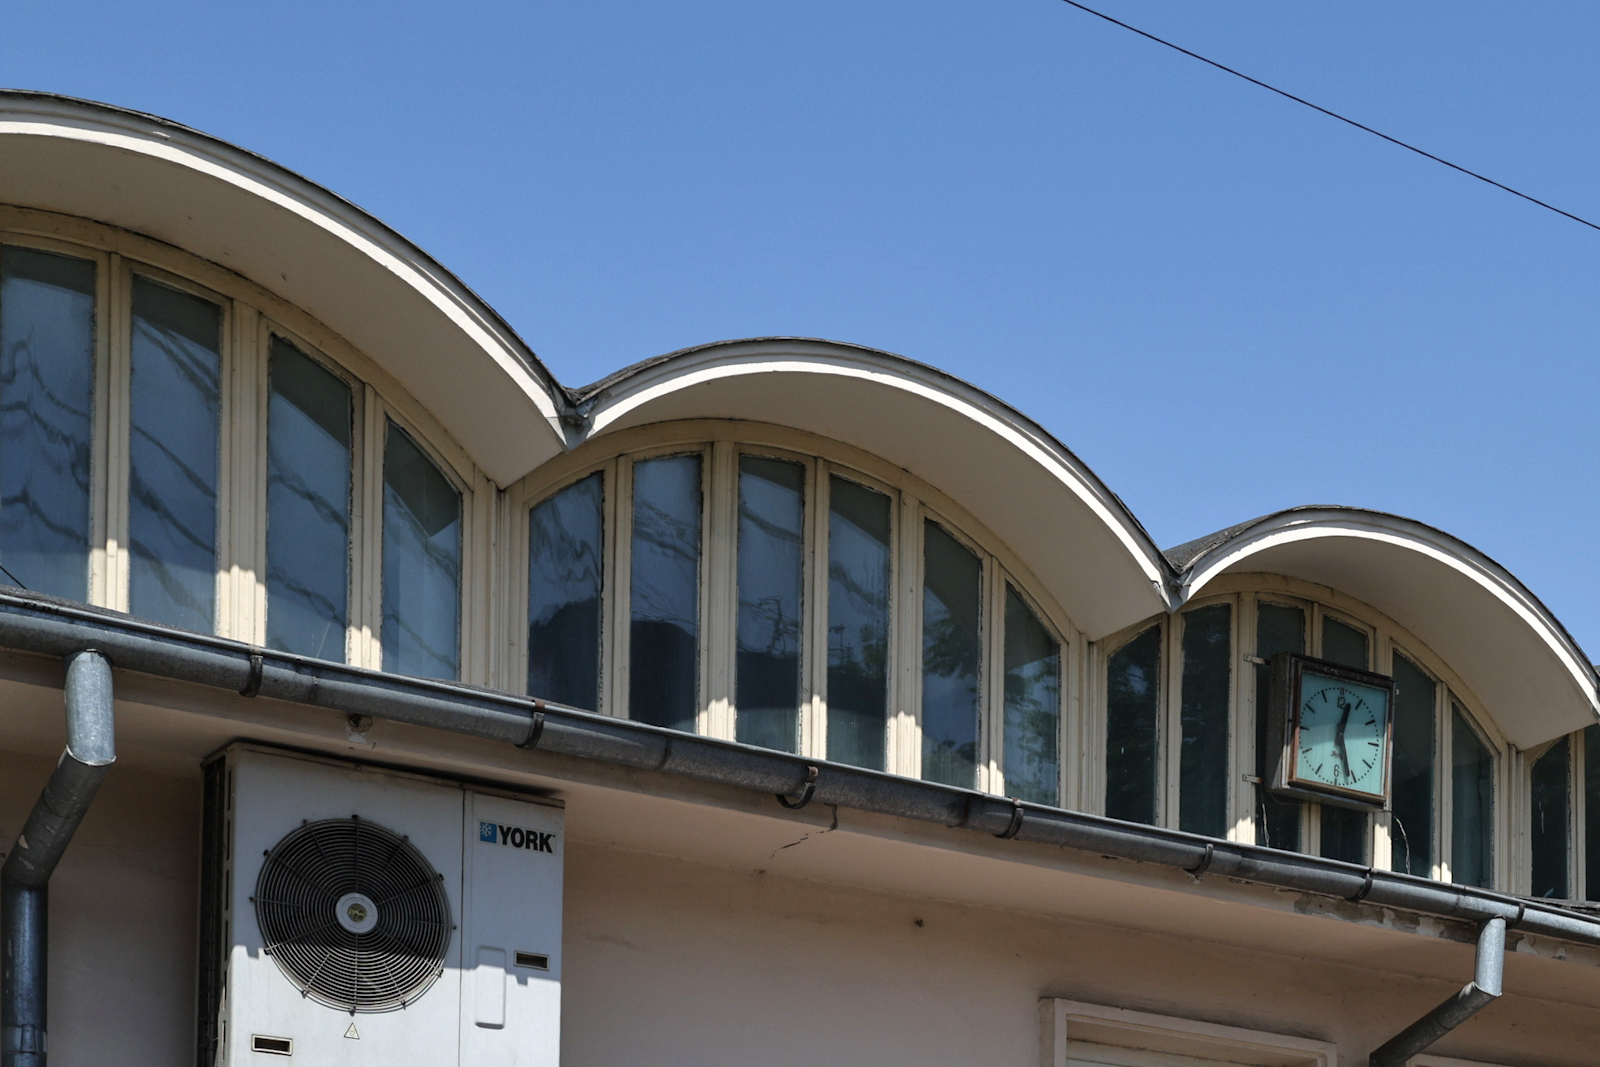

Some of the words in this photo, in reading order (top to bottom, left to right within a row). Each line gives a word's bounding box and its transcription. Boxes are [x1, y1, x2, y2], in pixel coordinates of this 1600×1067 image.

[1336, 696, 1346, 710] 12
[1333, 764, 1340, 778] 6
[498, 824, 554, 854] YORK
